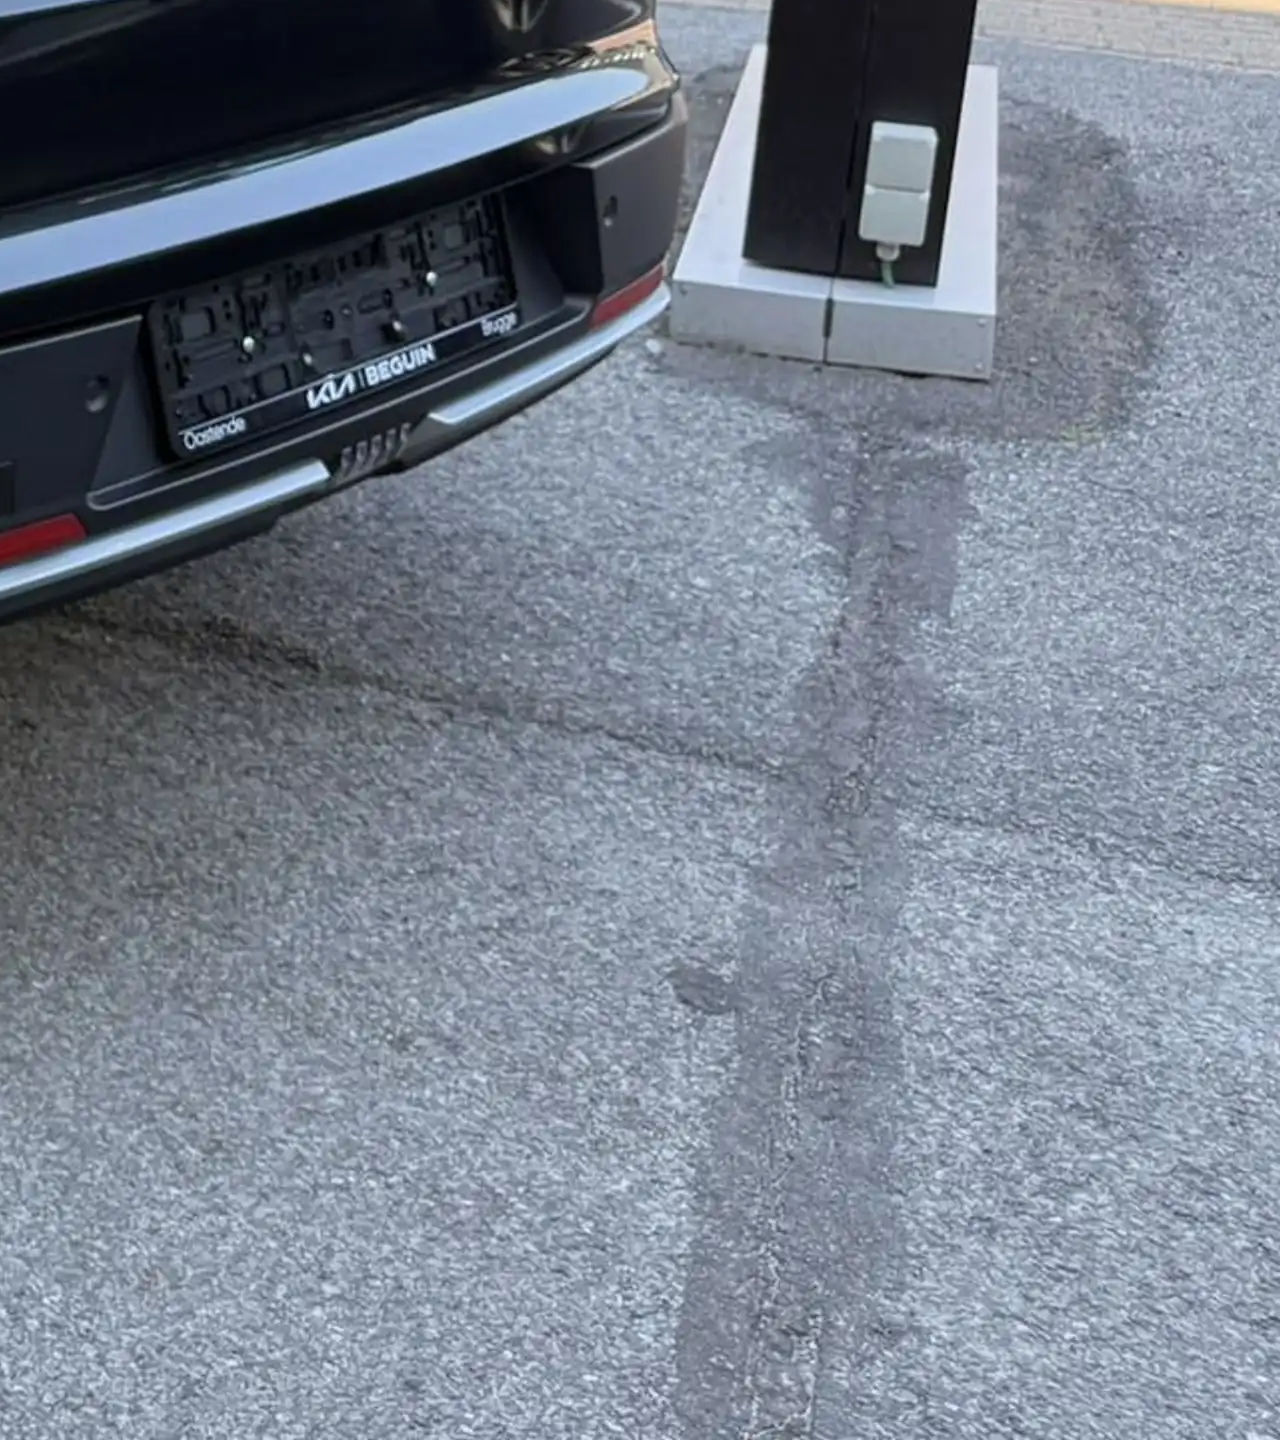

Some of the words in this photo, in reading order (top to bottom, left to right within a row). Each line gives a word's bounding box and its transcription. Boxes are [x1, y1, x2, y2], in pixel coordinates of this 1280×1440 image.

[183, 415, 248, 450] Oostende
[305, 374, 357, 410] KIA
[365, 343, 439, 386] BEGUIN
